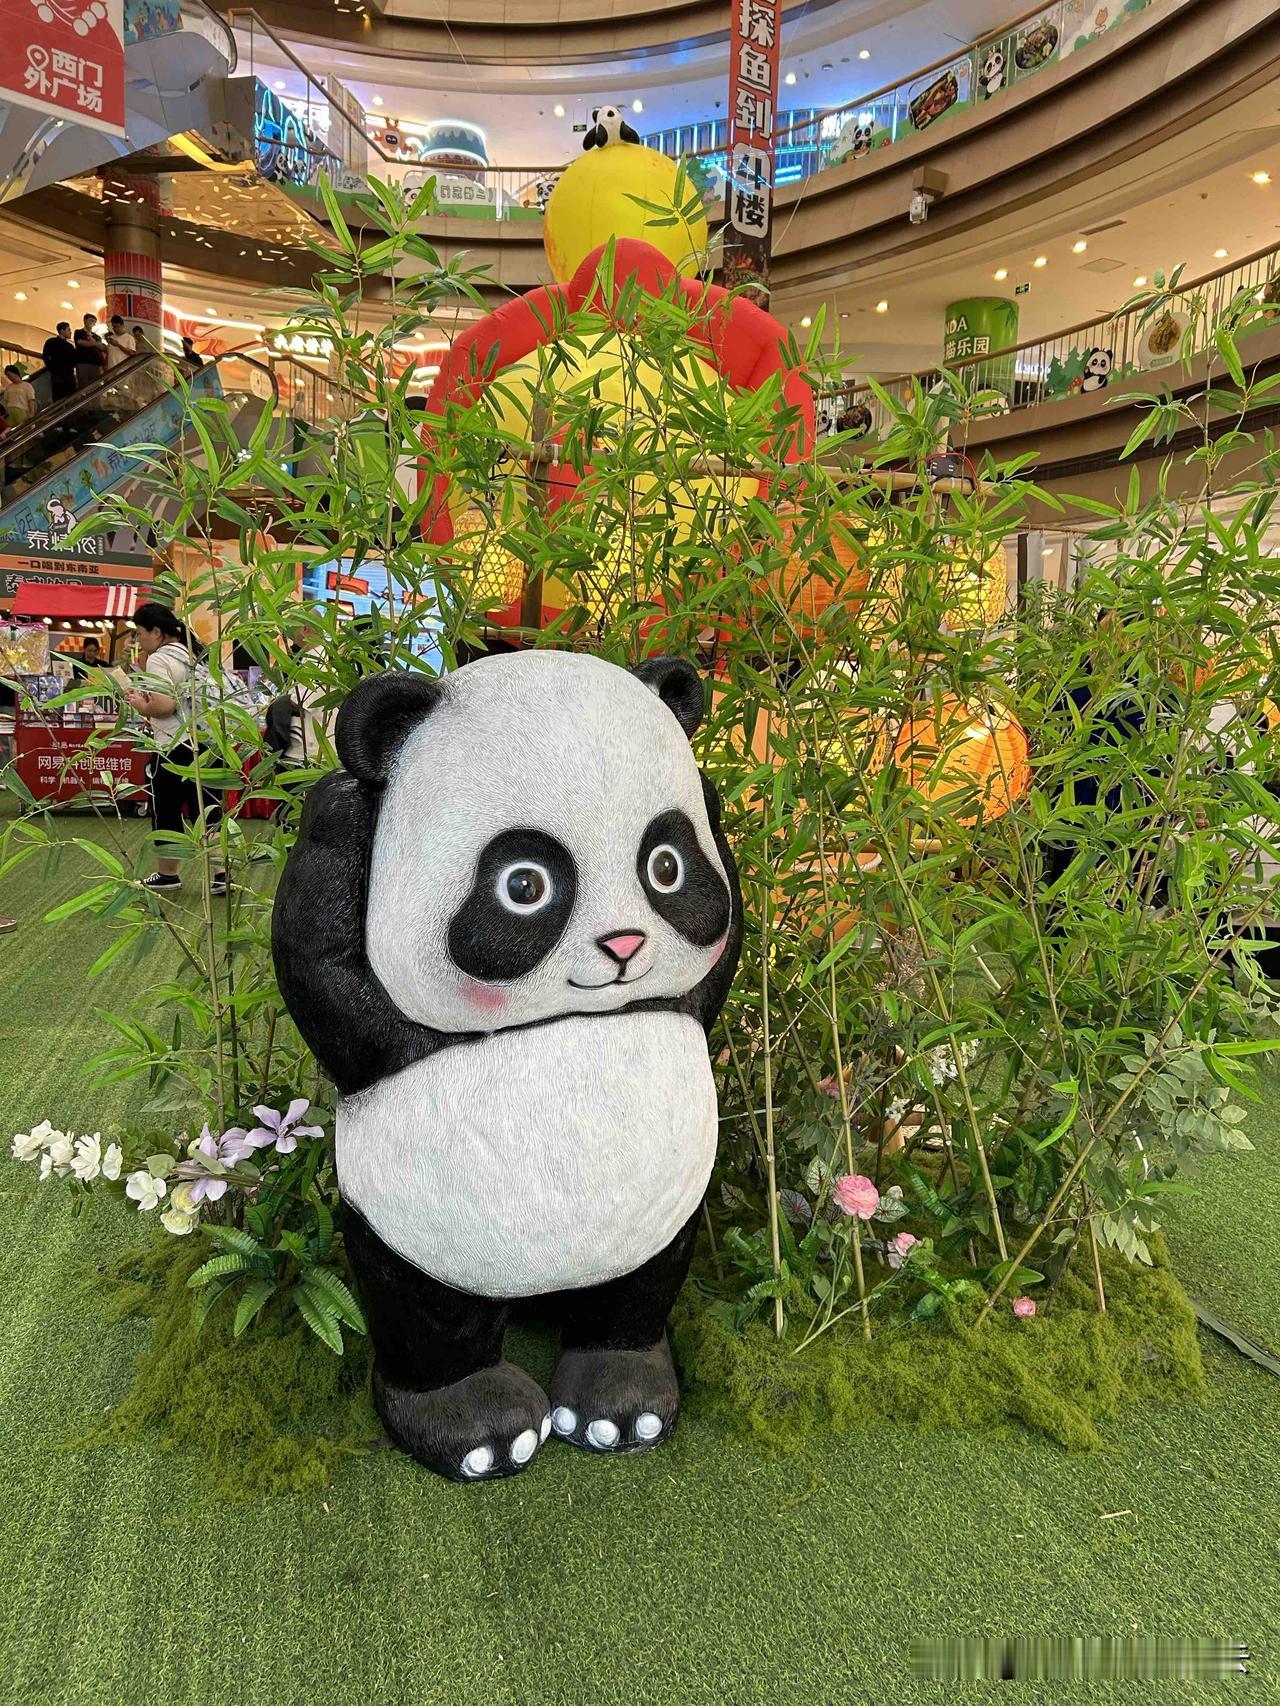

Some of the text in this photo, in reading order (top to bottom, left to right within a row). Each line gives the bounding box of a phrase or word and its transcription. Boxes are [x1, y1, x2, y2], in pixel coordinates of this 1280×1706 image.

[51, 48, 103, 87] 西门
[24, 66, 103, 113] 外广场
